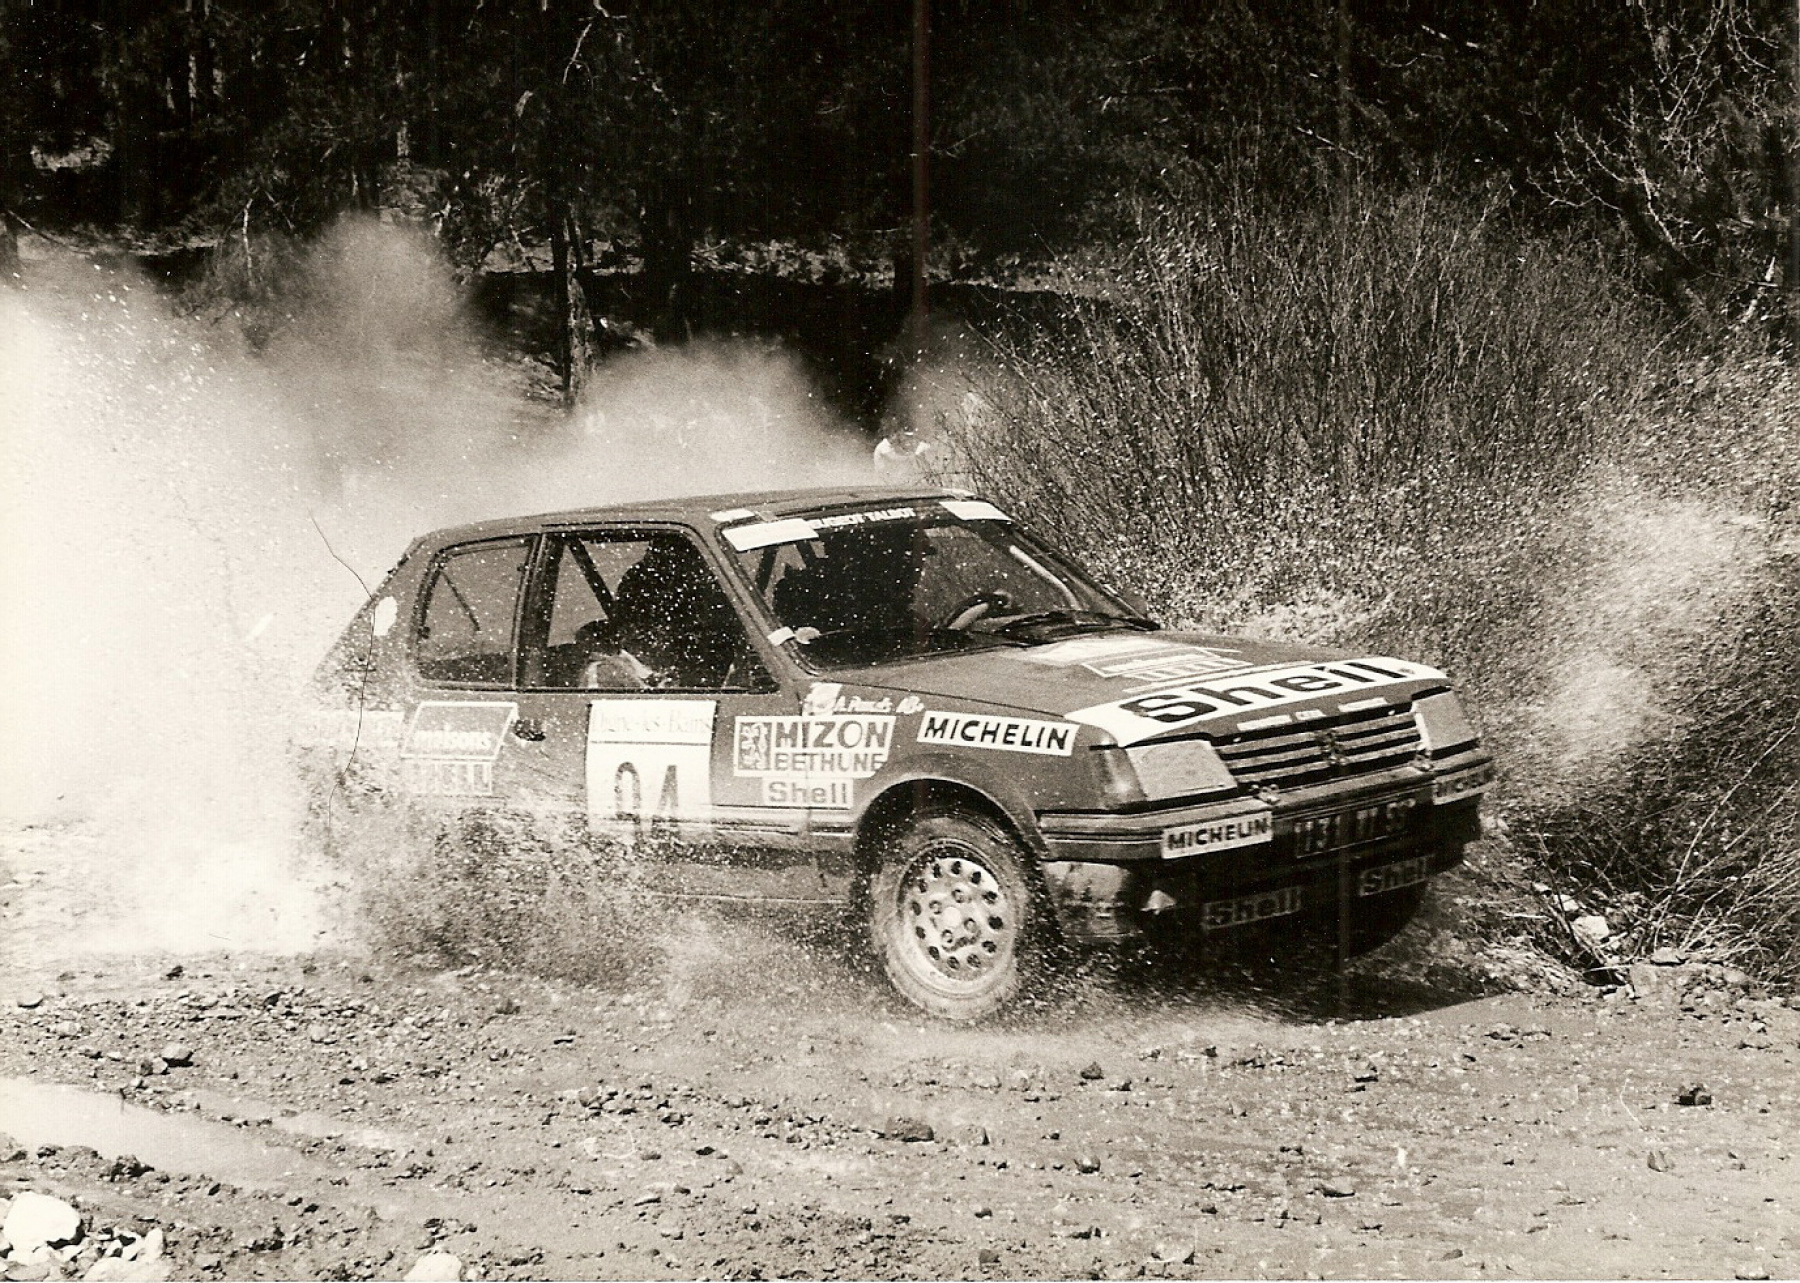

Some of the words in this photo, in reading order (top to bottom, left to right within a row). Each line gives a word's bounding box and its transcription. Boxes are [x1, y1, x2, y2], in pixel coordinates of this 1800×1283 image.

[1119, 662, 1407, 724] Shell
[774, 720, 889, 749] MIZON
[923, 716, 1070, 751] MICHELIN
[774, 752, 886, 772] BETHUNE
[767, 781, 847, 804] Shell
[1167, 817, 1268, 850] MICHELIN
